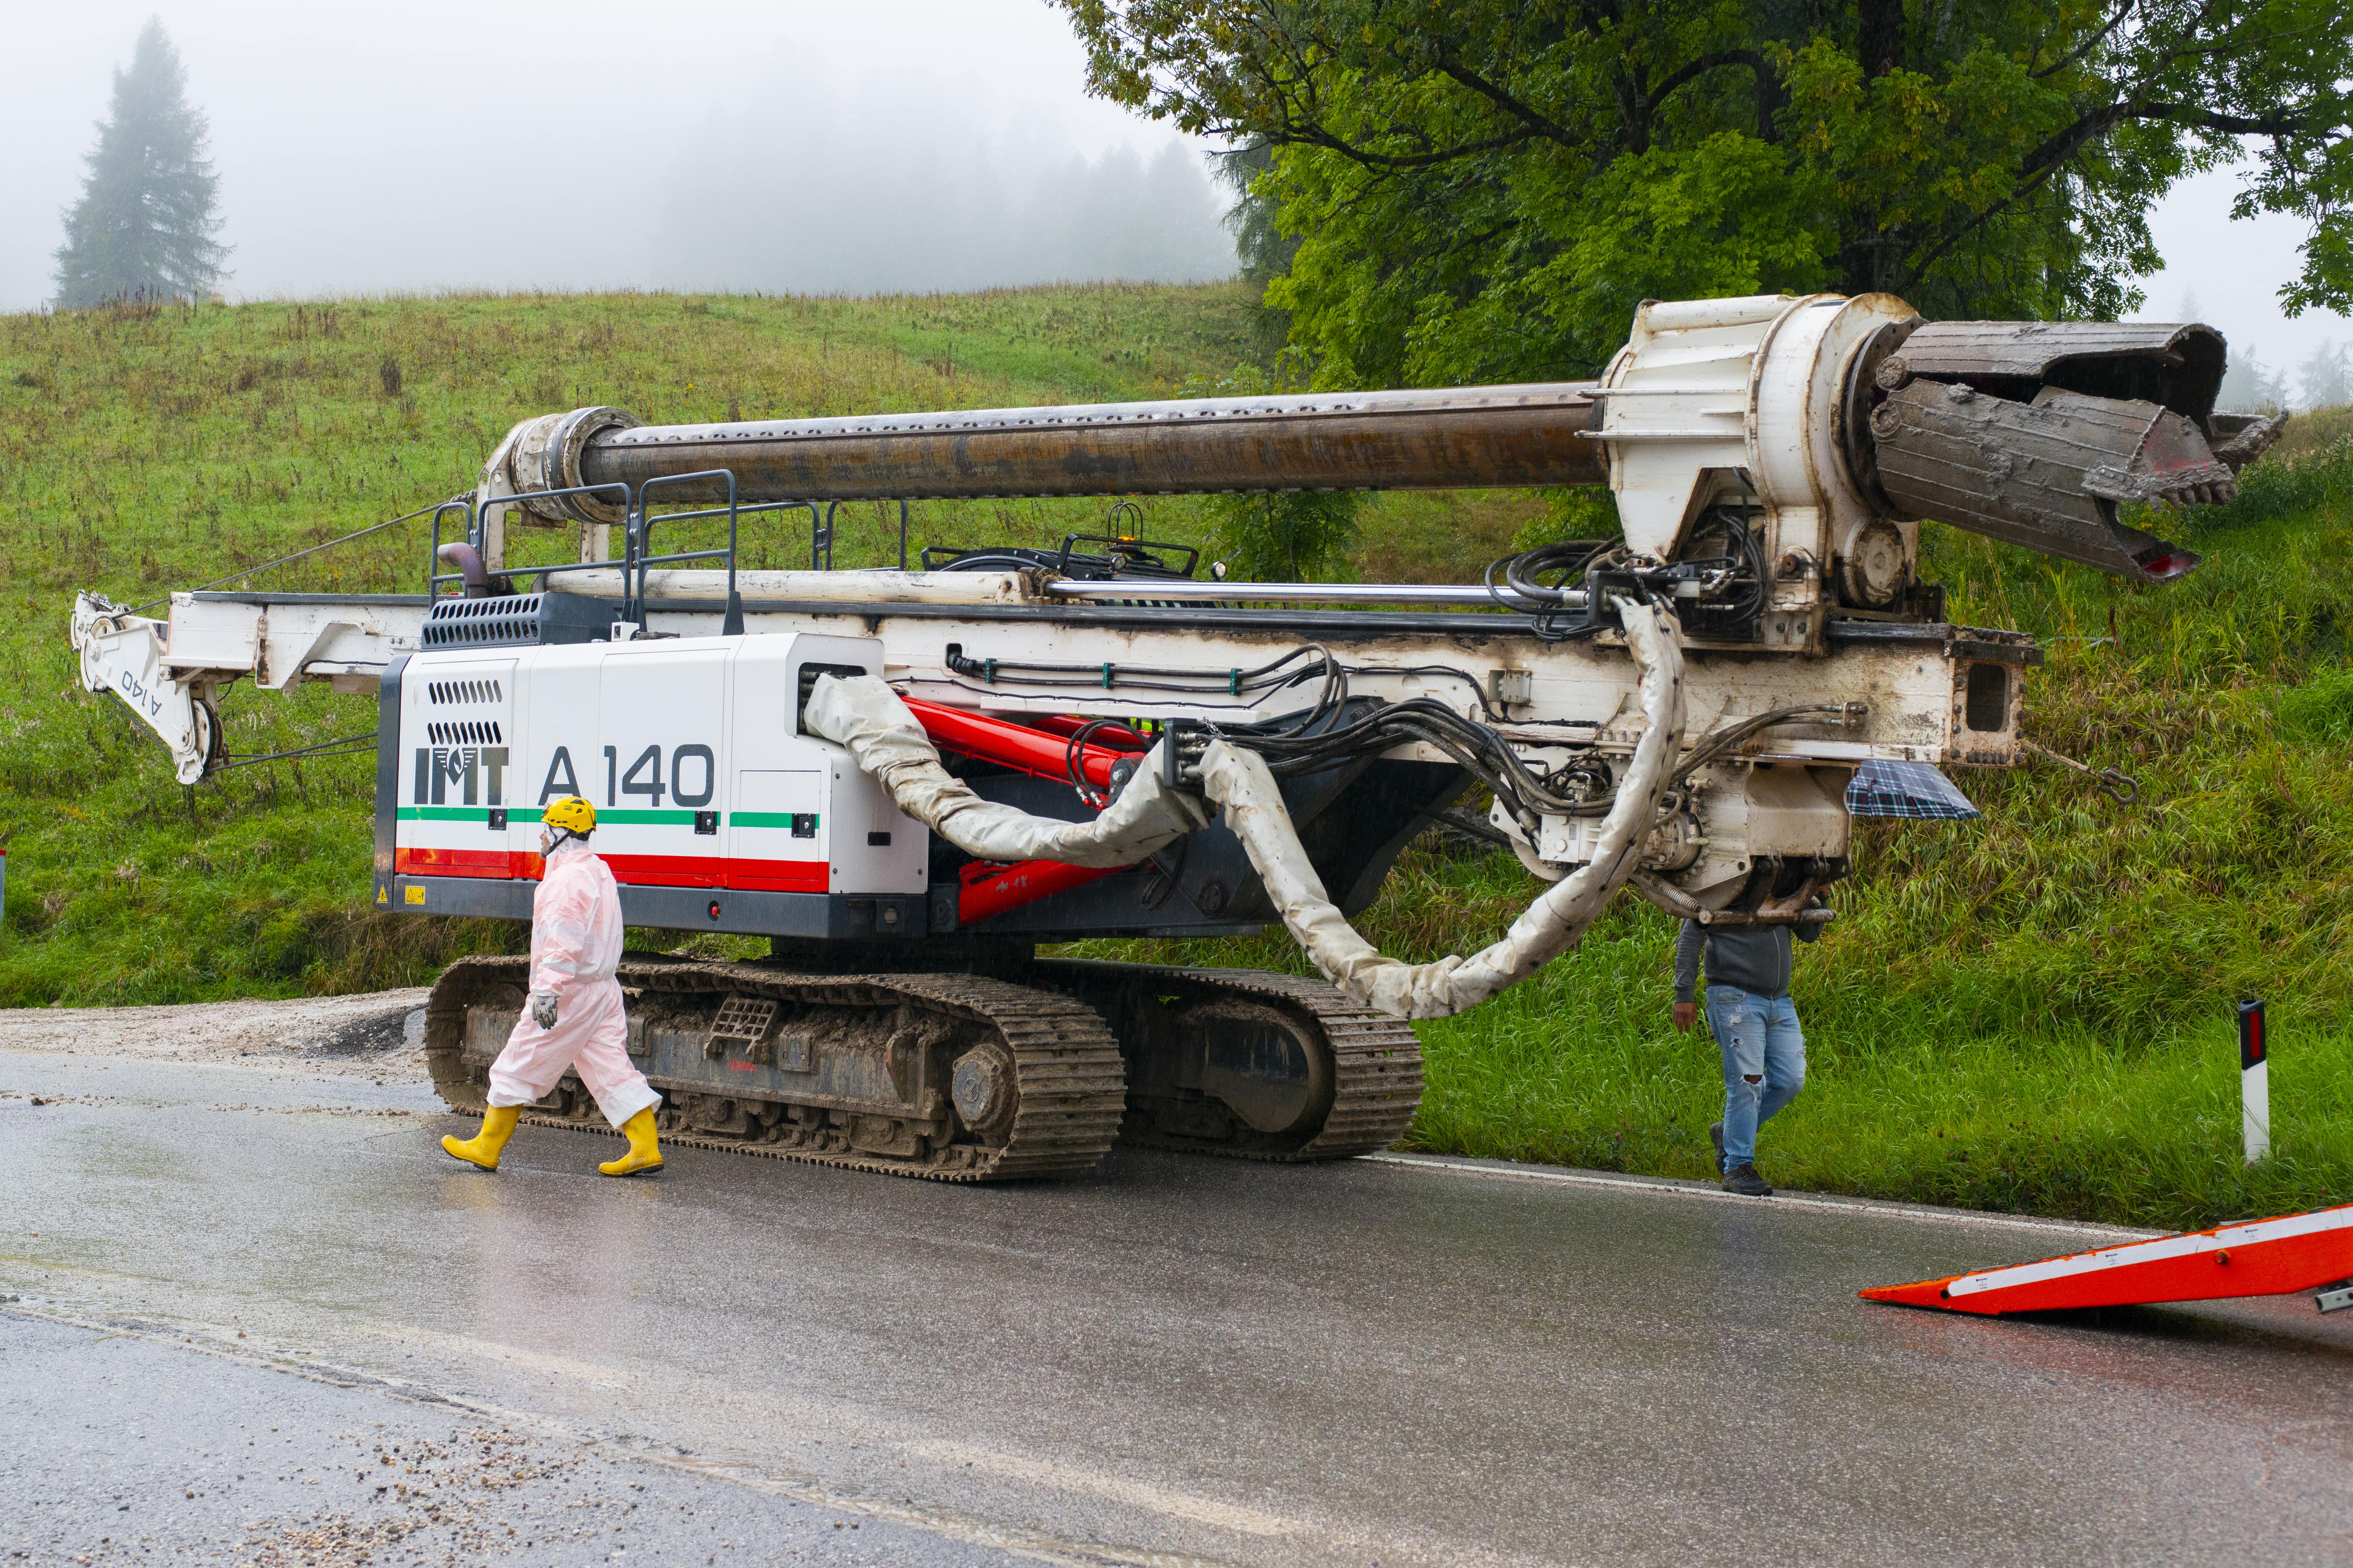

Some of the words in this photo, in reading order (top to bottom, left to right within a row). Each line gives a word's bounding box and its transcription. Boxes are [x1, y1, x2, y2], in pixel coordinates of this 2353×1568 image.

[414, 747, 509, 805] IMT
[538, 746, 582, 806] A
[604, 744, 714, 807] 140
